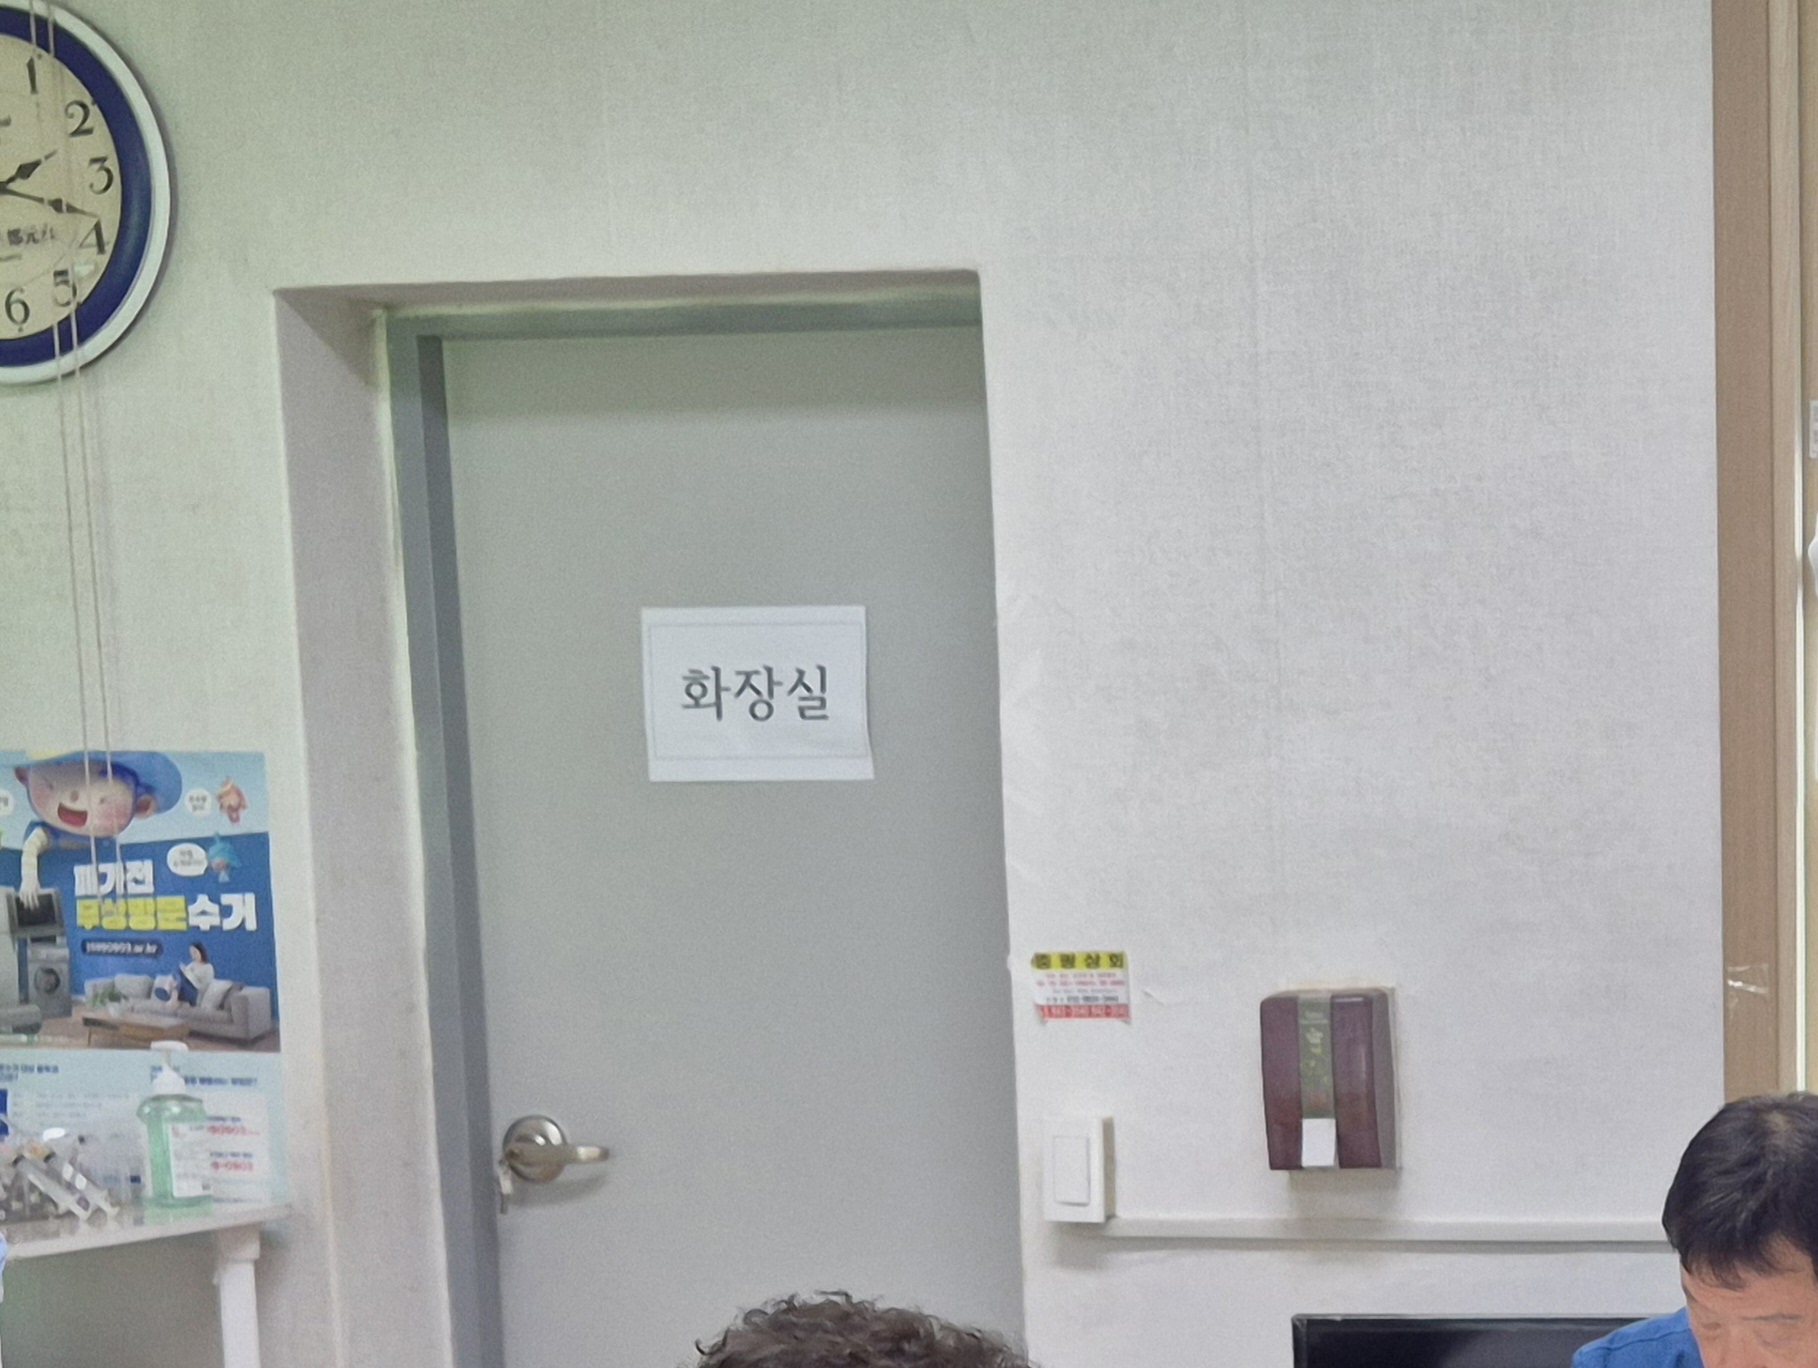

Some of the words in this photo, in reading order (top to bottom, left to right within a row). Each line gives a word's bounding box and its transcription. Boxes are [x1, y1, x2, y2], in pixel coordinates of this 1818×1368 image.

[26, 56, 38, 94] 1
[65, 101, 94, 138] 2
[88, 156, 114, 195] 3
[79, 218, 110, 255] 4
[4, 288, 31, 326] 6
[52, 268, 77, 308] 5
[681, 664, 829, 722] 화장실
